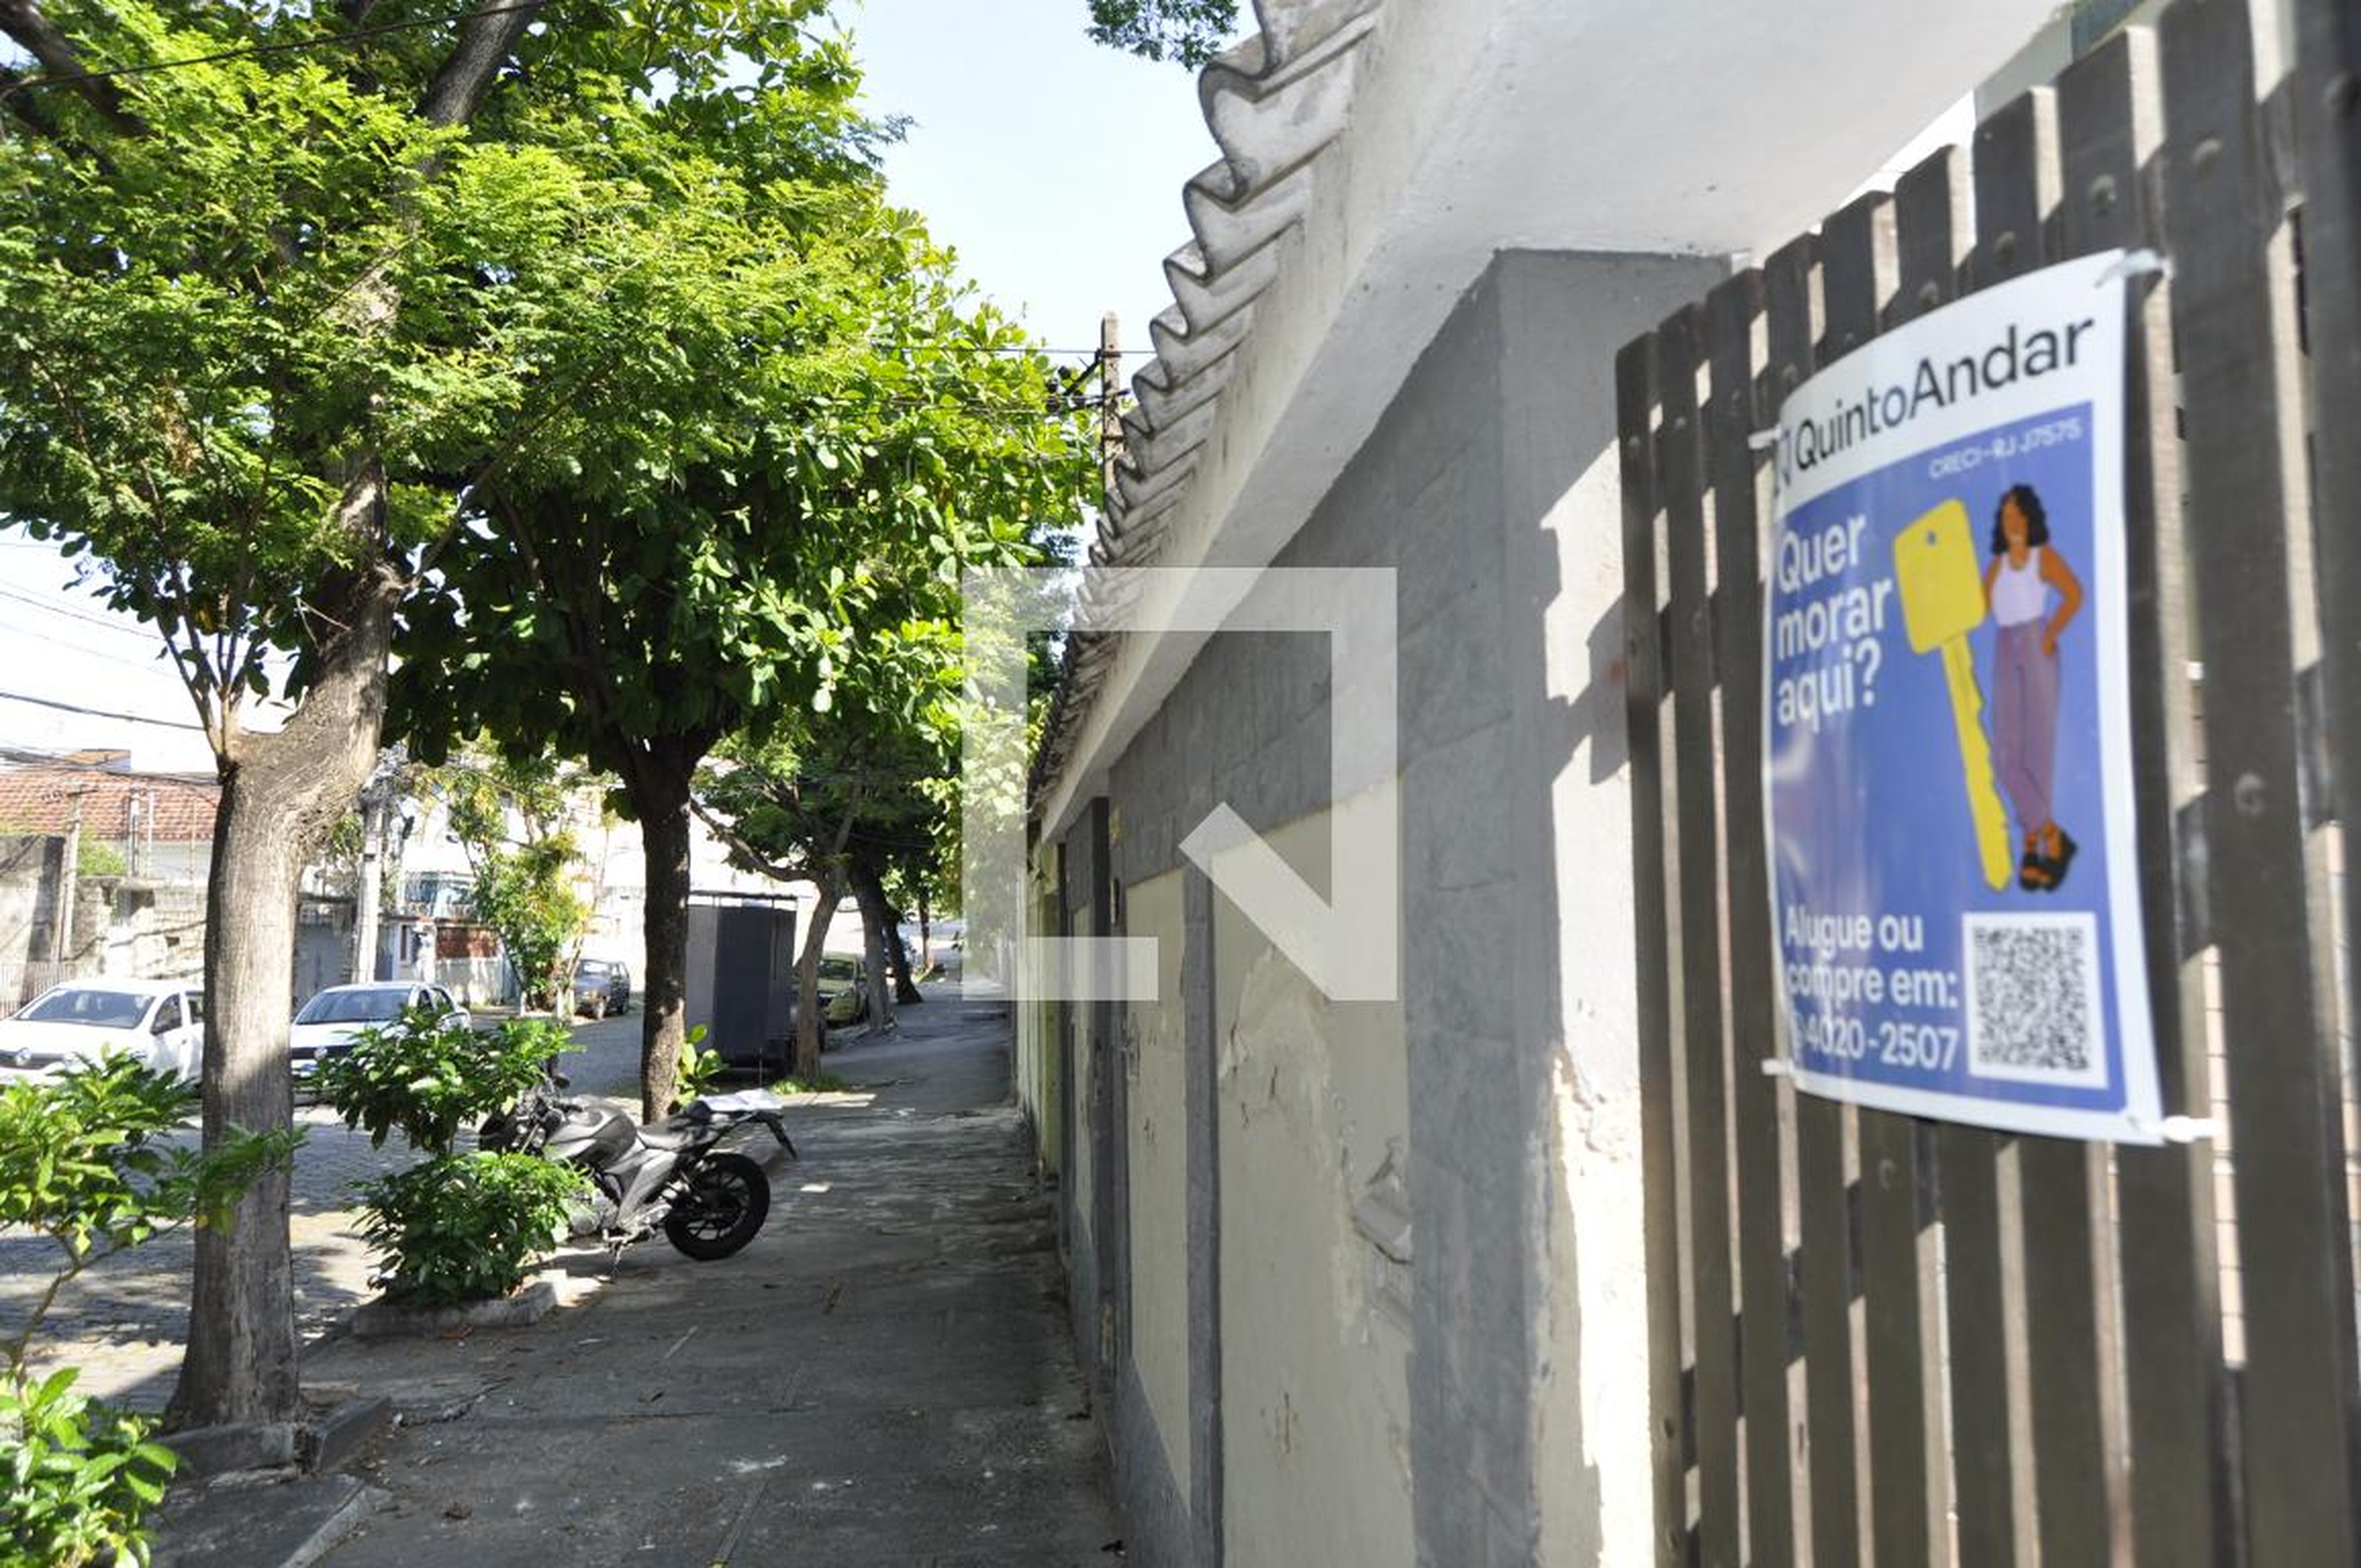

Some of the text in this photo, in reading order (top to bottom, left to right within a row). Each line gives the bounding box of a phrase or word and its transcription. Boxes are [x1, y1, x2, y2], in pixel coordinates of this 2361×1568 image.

[1796, 315, 2094, 471] QuintoAndar
[1779, 513, 1867, 593] Quer
[1778, 578, 1893, 660] morar
[1778, 637, 1881, 733] aqui?
[1786, 905, 1923, 959] Alugue ou
[1787, 963, 1958, 1009] compre em:
[1805, 1015, 1960, 1071] 4020-2507
